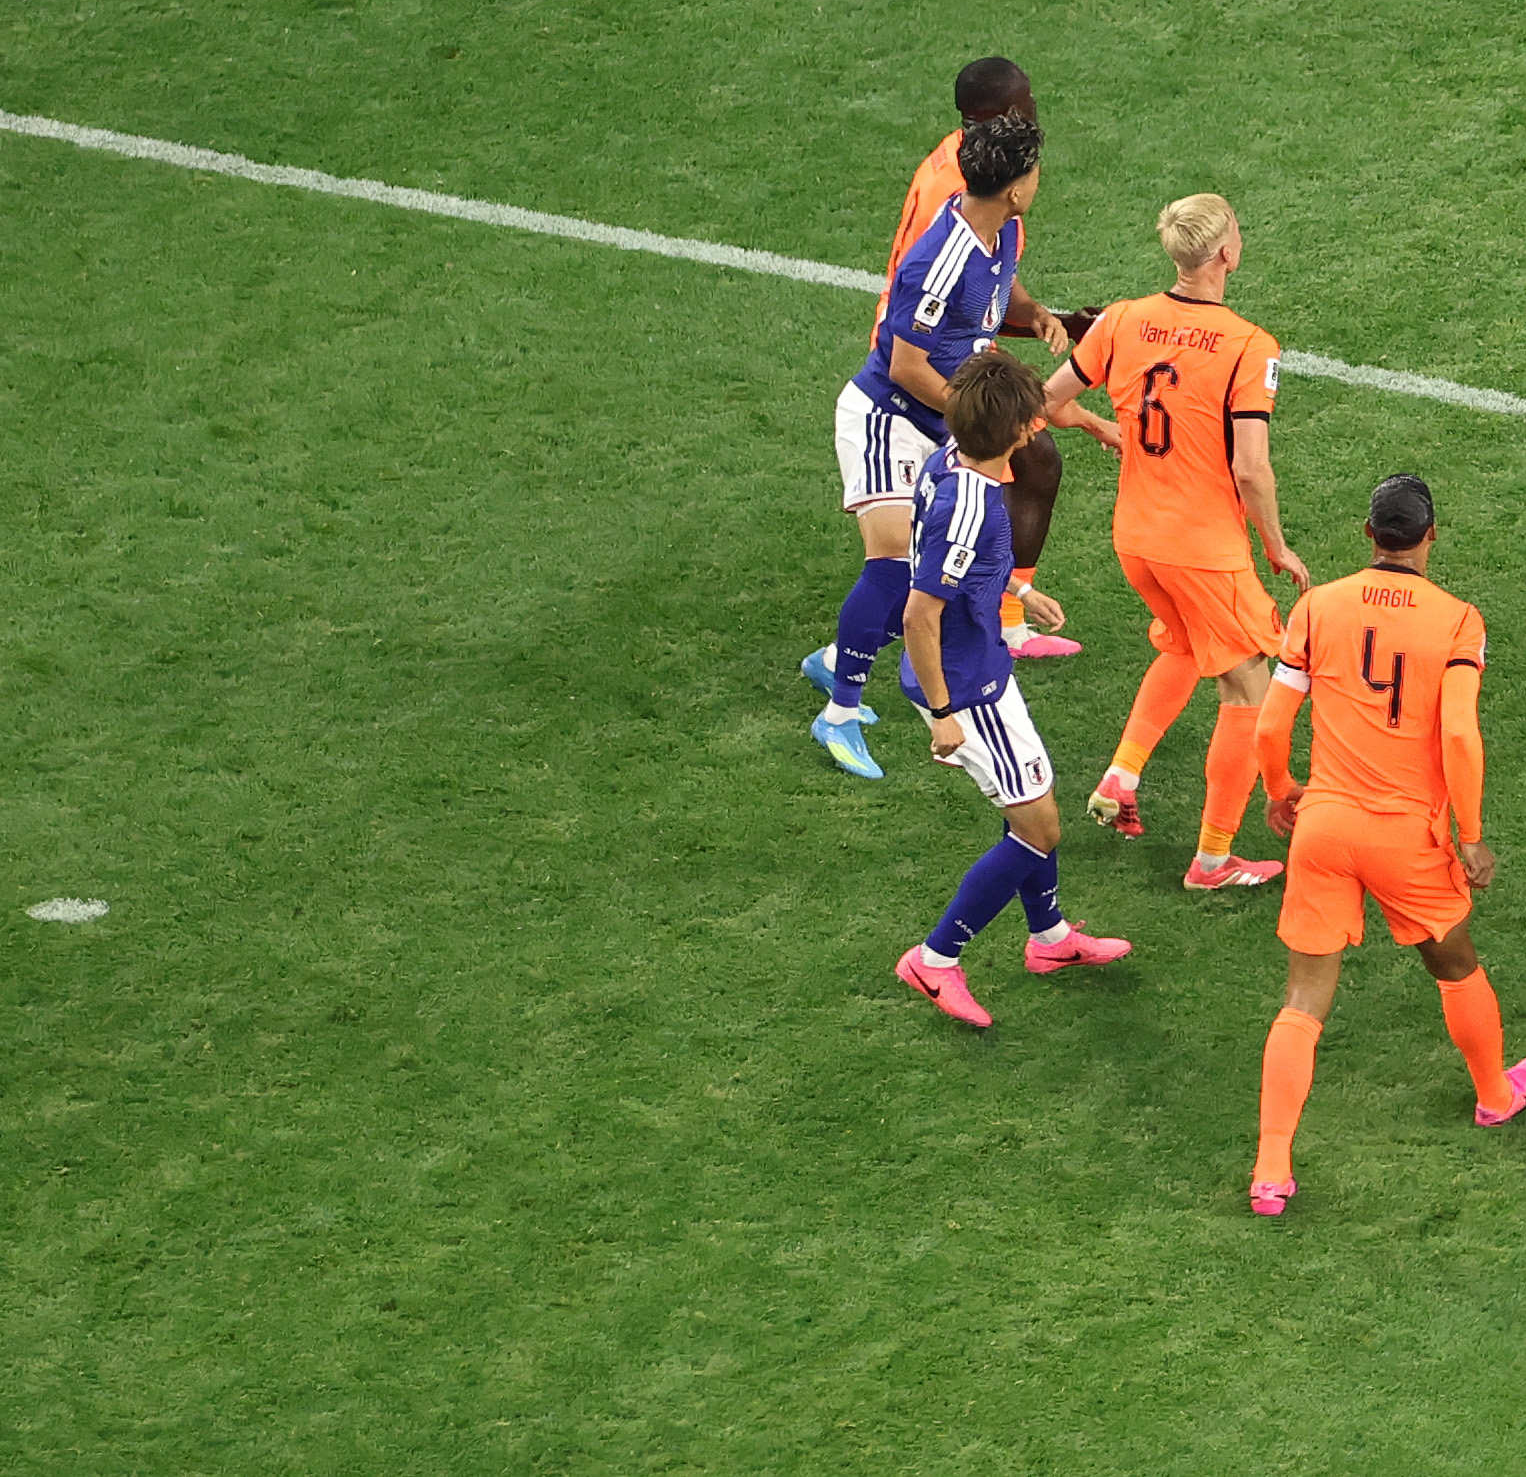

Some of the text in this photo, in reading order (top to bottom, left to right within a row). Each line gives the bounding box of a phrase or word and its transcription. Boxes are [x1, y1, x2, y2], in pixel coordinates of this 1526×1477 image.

[1138, 361, 1181, 459] 6
[1362, 585, 1418, 608] VIRGIL
[1360, 626, 1406, 728] 4
